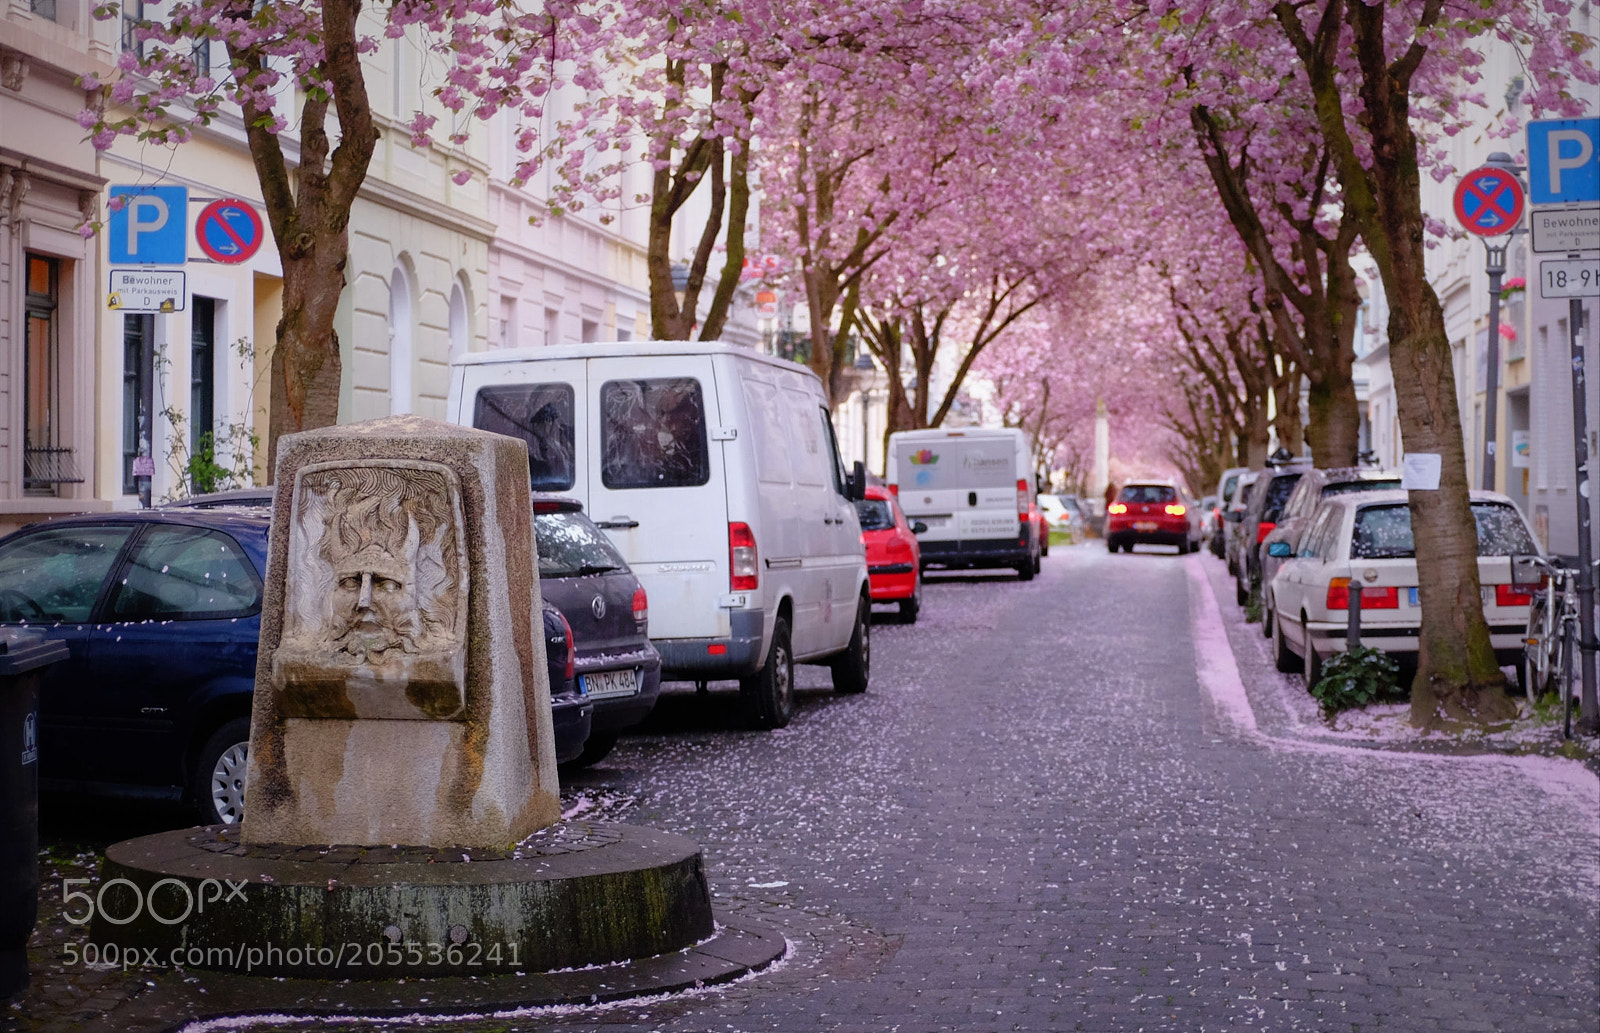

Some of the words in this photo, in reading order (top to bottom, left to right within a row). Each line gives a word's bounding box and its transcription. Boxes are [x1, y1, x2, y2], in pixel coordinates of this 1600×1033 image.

[1548, 130, 1594, 194] P
[127, 195, 169, 255] P
[122, 275, 174, 285] Bewohner
[132, 287, 178, 295] Parkausweis
[143, 296, 151, 306] D
[585, 676, 600, 692] BN
[603, 673, 618, 690] PK
[619, 671, 637, 689] 484
